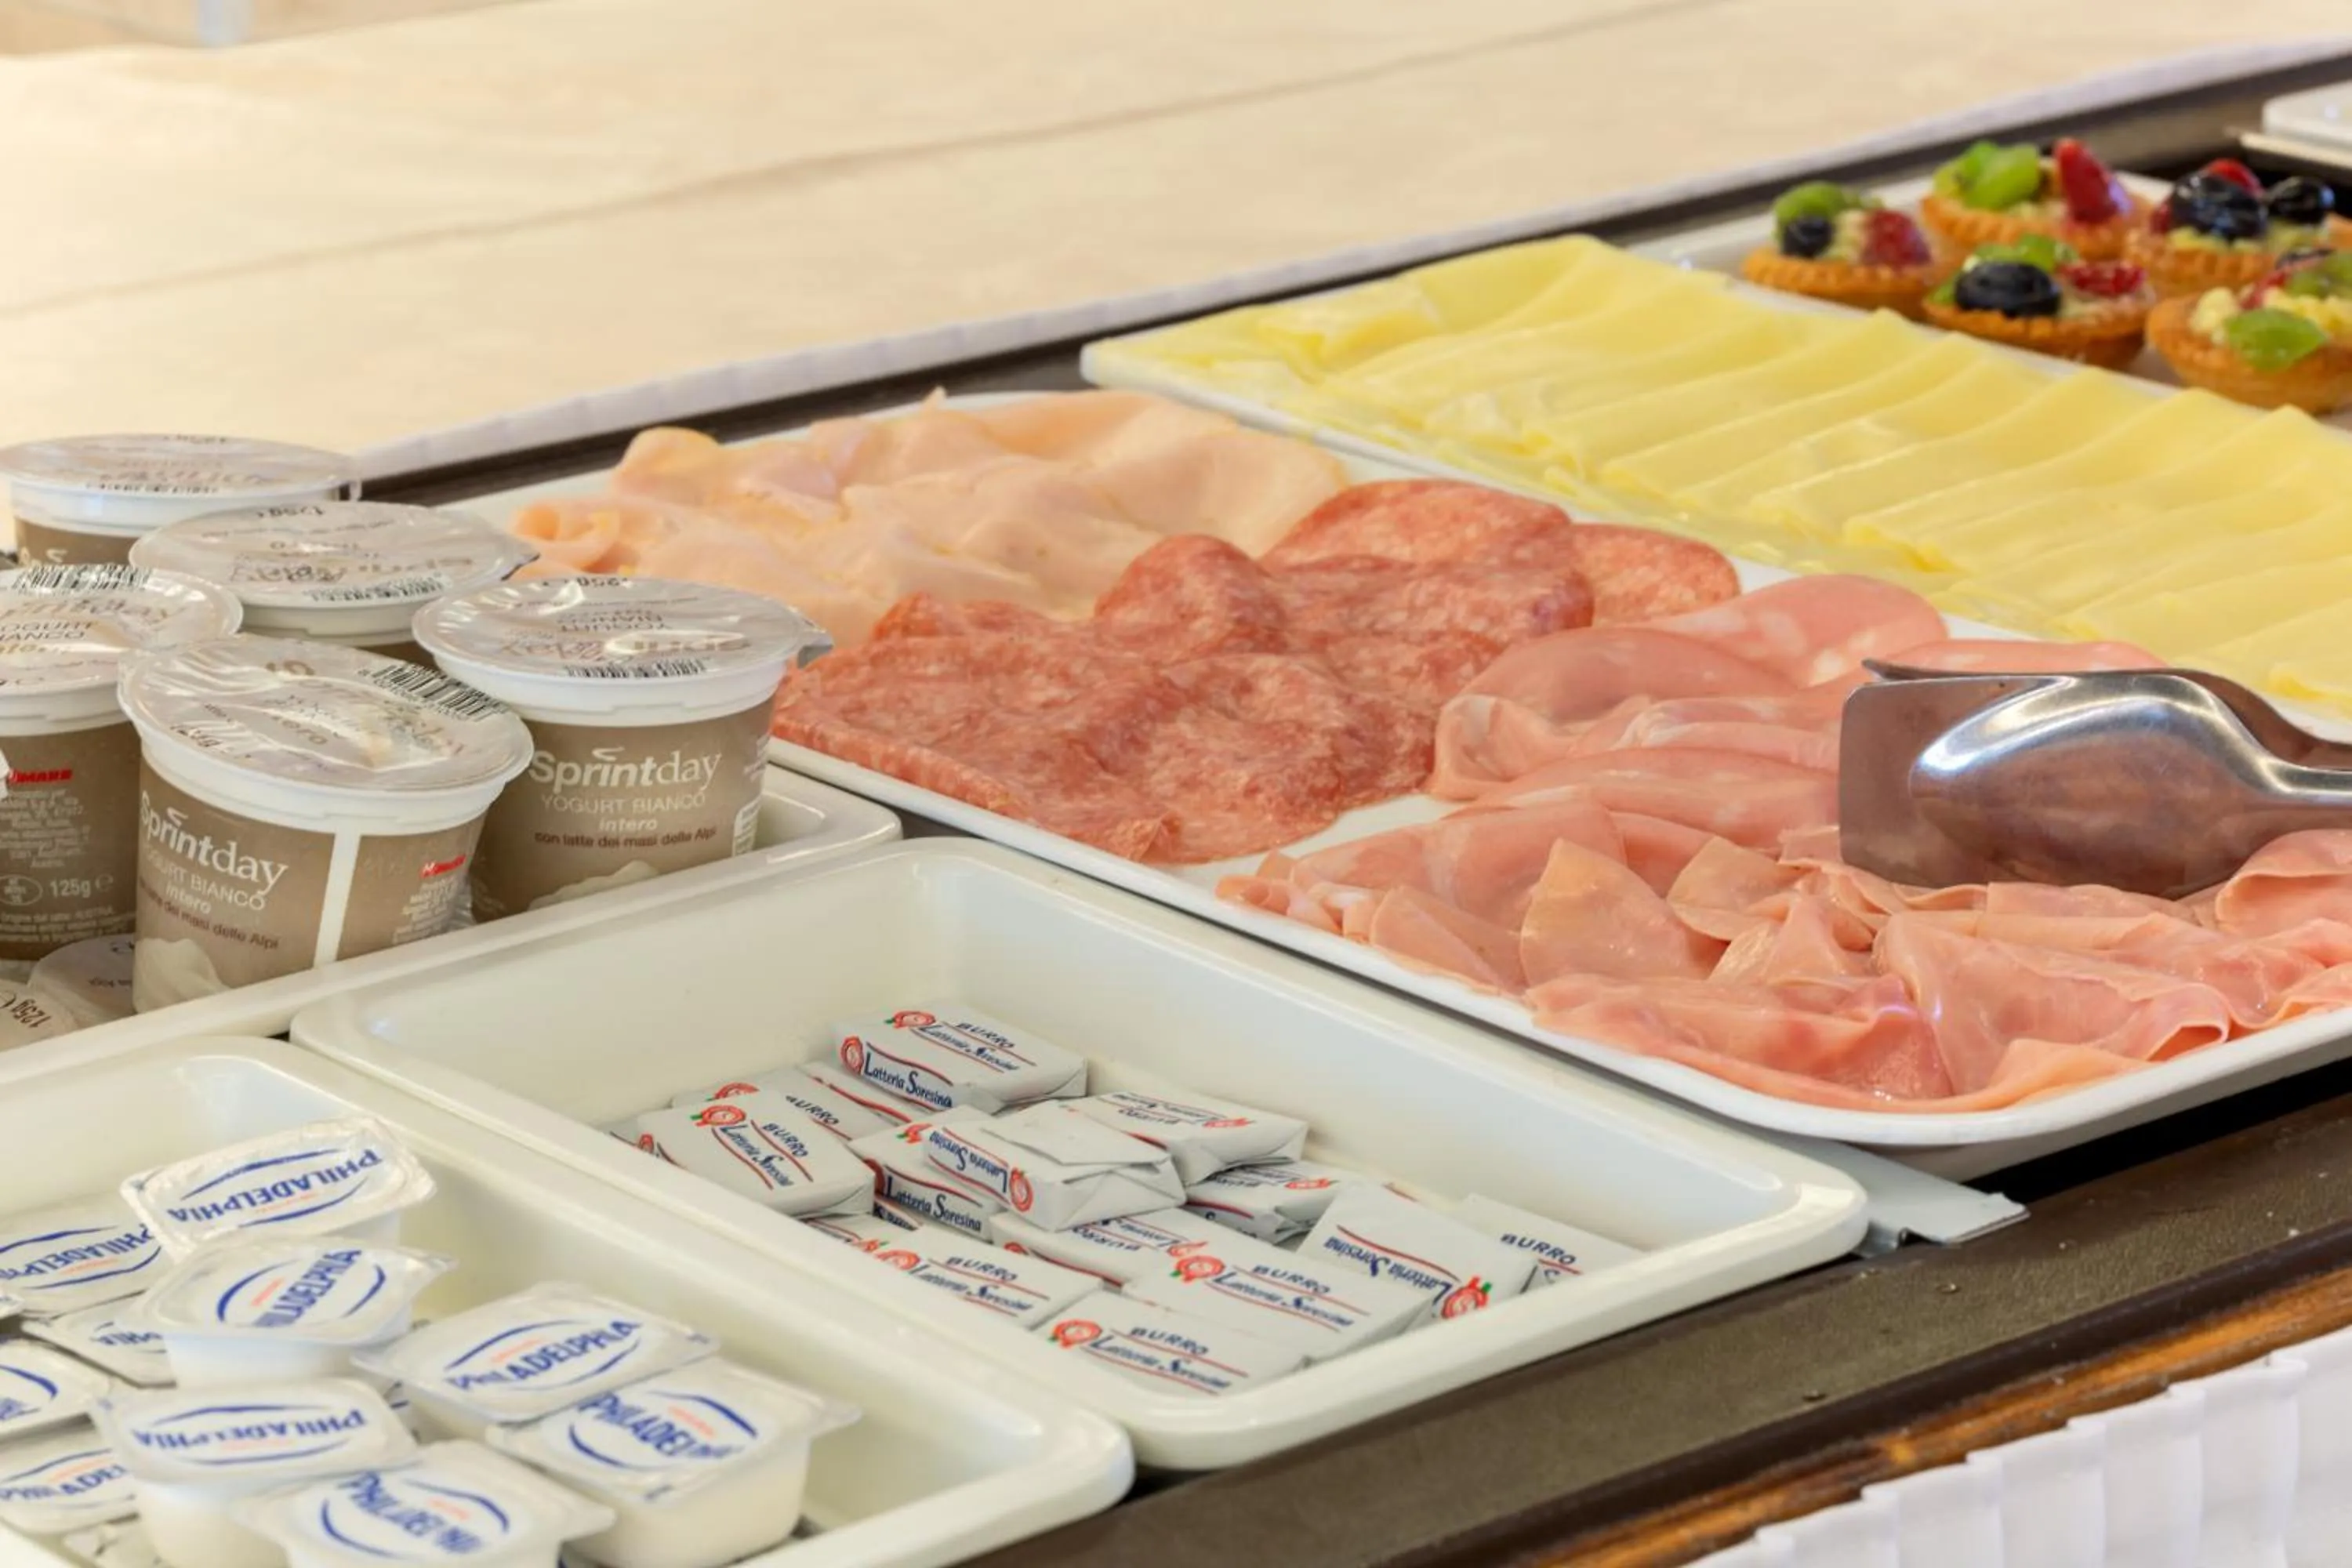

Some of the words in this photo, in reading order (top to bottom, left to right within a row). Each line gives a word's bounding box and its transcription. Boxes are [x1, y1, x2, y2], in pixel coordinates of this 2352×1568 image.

[528, 746, 722, 795] Sprintday
[541, 793, 626, 815] YOGURT
[631, 791, 706, 814] BIANCO
[598, 817, 659, 832] intero
[140, 789, 289, 896] Sprintday
[49, 878, 92, 898] 125g
[190, 873, 265, 911] BIANCO
[863, 1051, 905, 1089] Latteria
[906, 1069, 953, 1109] Soresina
[762, 1122, 809, 1159] BURRO
[166, 1148, 383, 1224] PHILADELPHIA
[885, 1174, 932, 1214] Latteria
[933, 1193, 982, 1232] Soresina
[1501, 1232, 1577, 1266] BURRO
[946, 1255, 1018, 1282] BURRO
[1253, 1264, 1331, 1294] BURRO
[1130, 1326, 1209, 1356] BURRO
